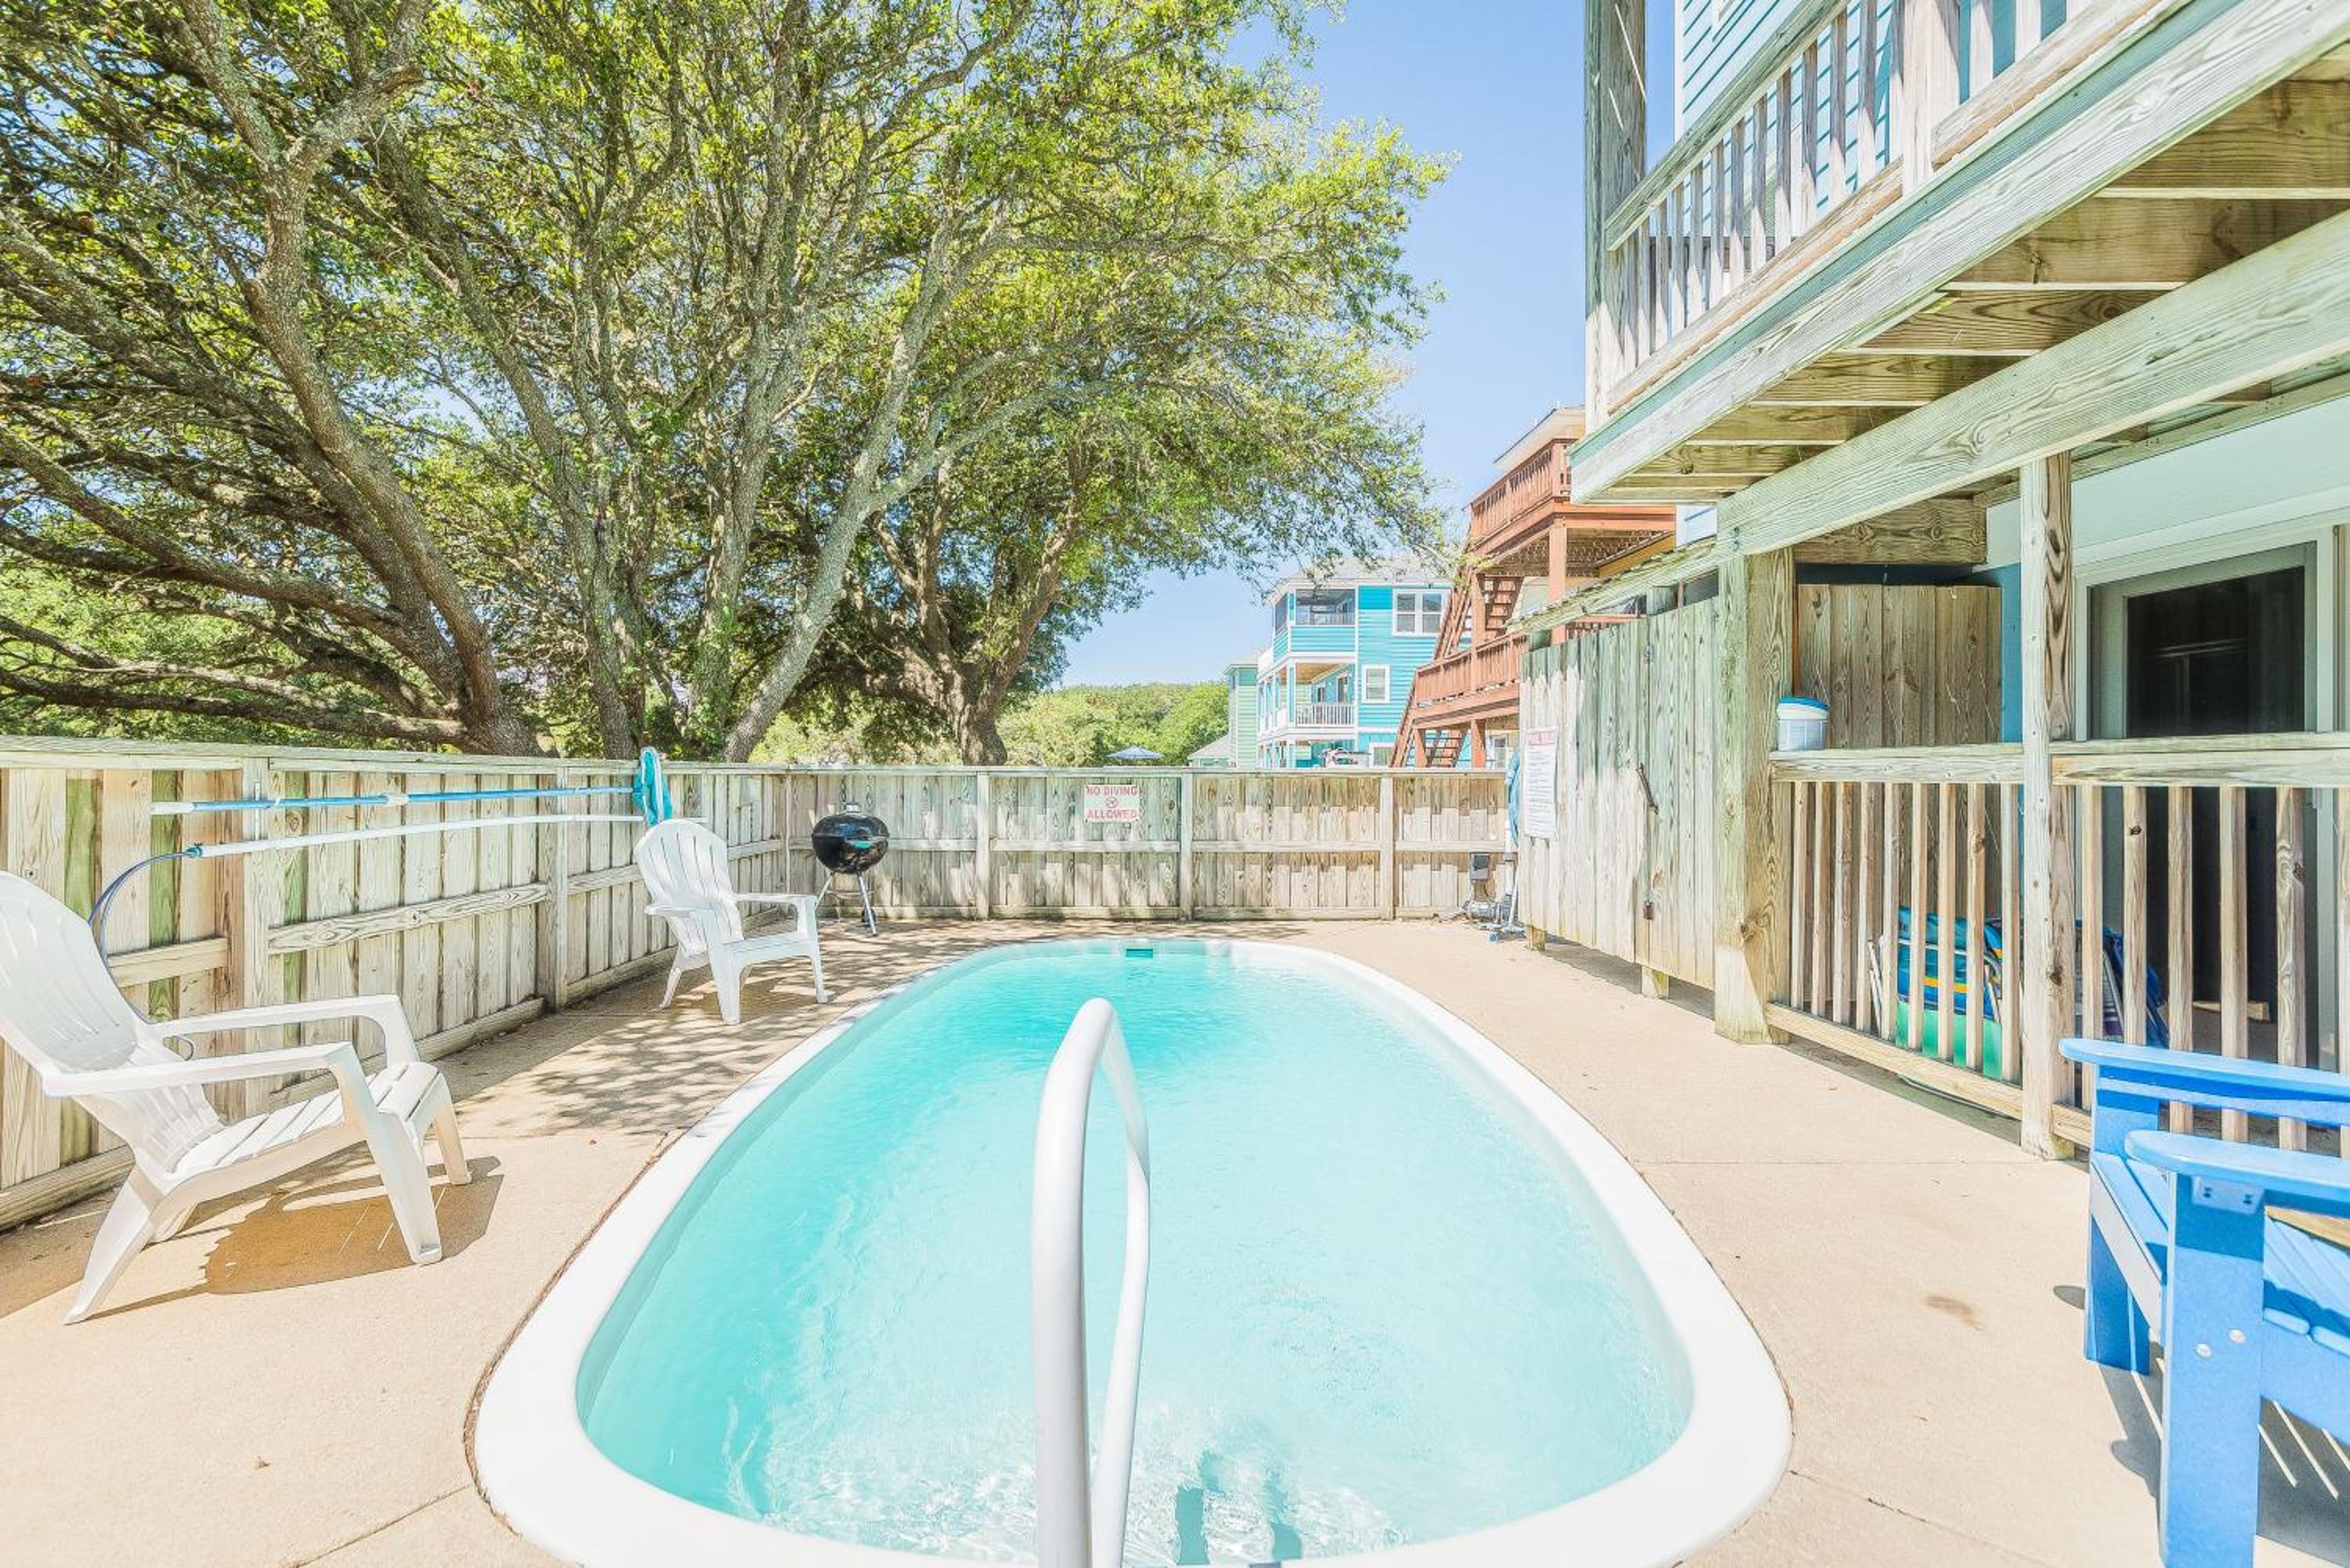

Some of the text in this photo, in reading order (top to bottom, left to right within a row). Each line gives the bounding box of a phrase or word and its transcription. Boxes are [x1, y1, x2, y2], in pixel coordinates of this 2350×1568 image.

[1086, 786, 1138, 796] NO DIVING
[1086, 809, 1137, 819] ALLOWED
